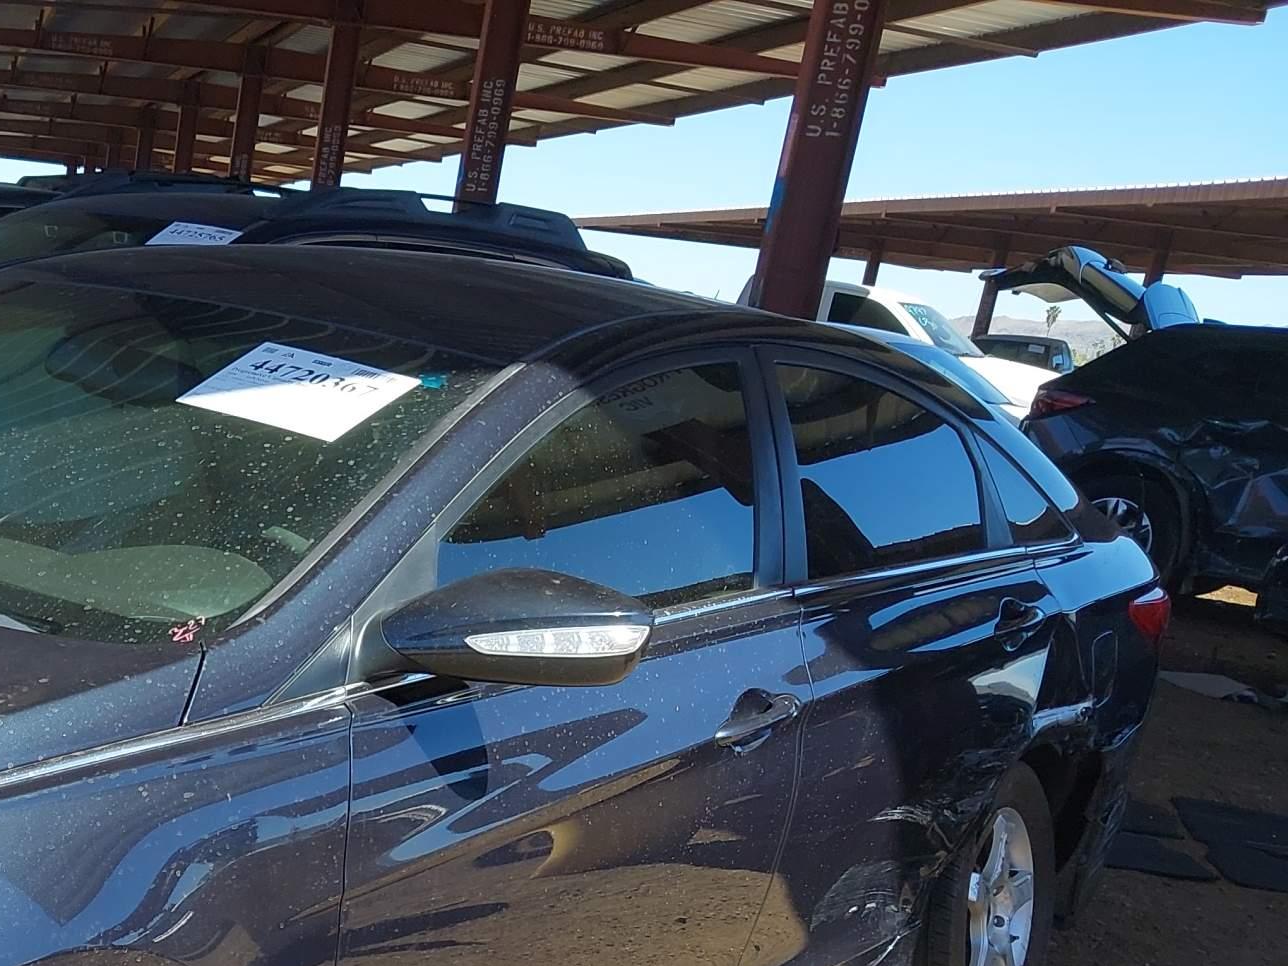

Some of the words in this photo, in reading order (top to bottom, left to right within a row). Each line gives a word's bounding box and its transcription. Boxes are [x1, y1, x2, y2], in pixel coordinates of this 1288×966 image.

[817, 1, 849, 85] PREFAB
[472, 109, 489, 160] PREFAB
[481, 80, 493, 102] INC
[806, 98, 830, 137] U.S.
[248, 359, 379, 397] 44720367
